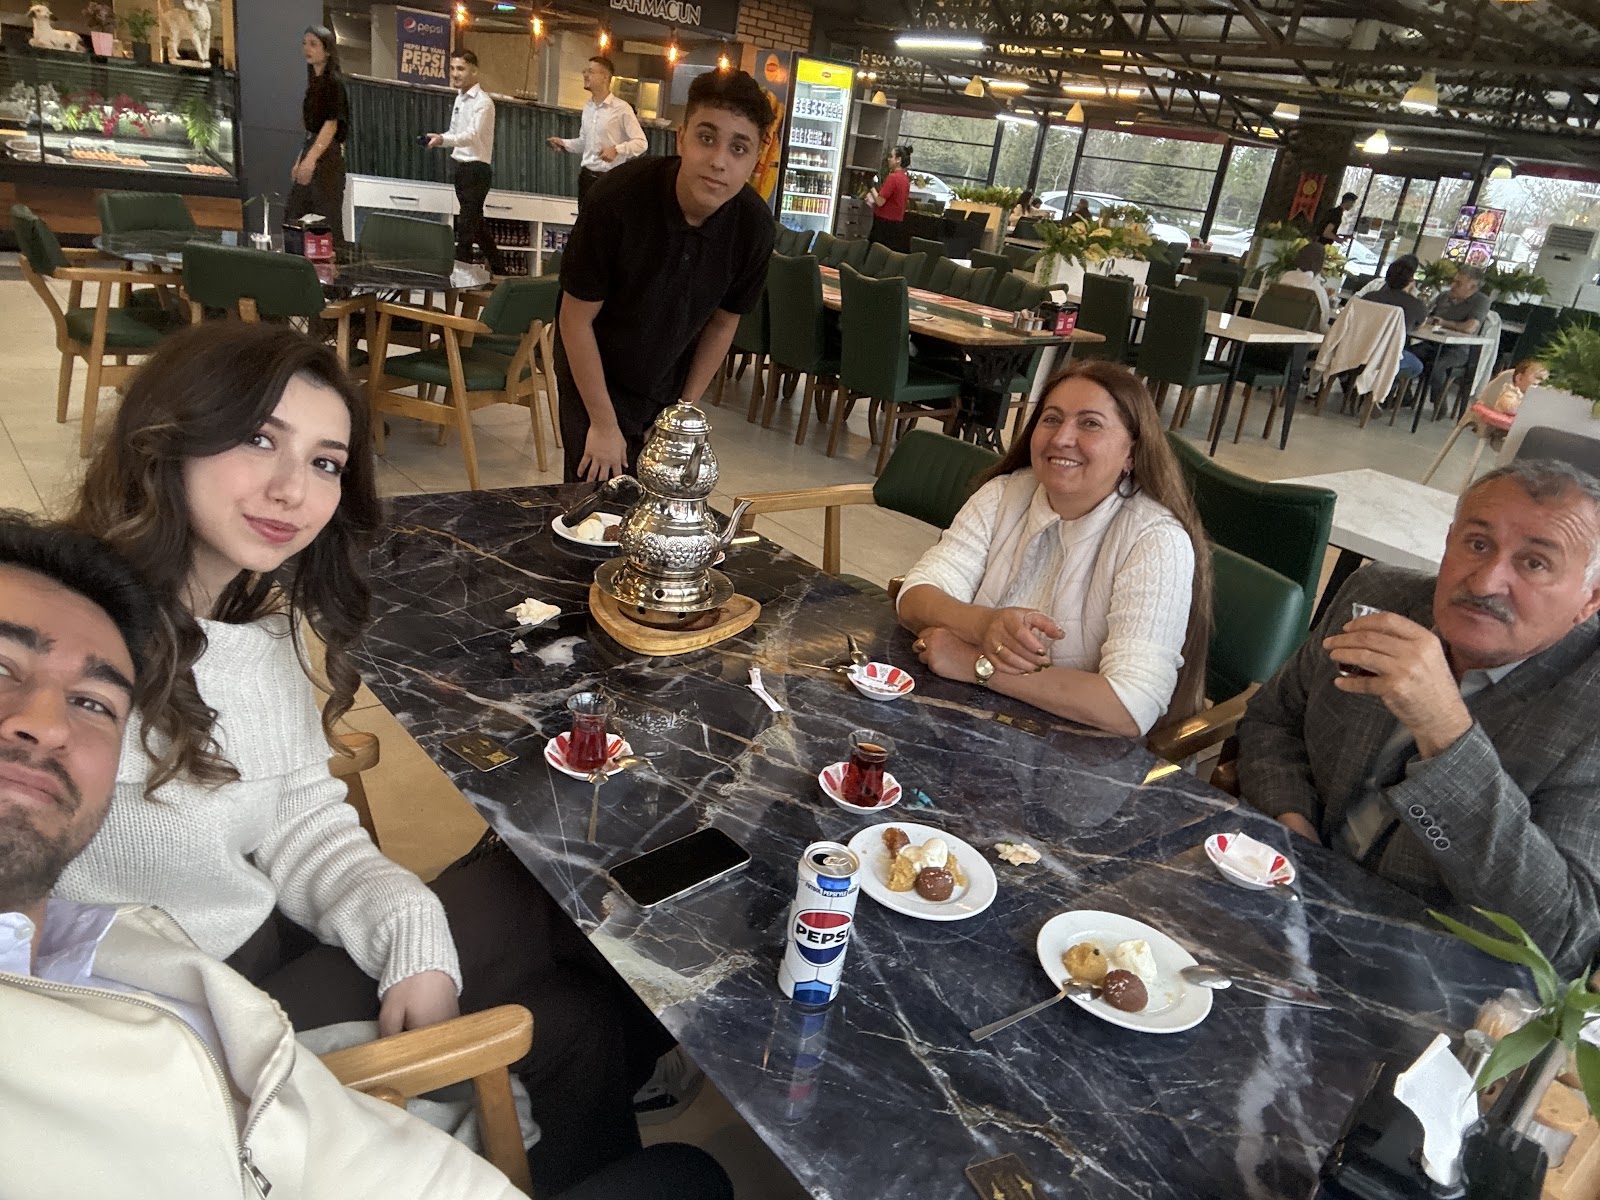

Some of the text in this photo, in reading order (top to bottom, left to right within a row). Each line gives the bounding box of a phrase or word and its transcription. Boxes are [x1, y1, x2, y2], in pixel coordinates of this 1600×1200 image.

[417, 23, 444, 34] pepsi
[402, 49, 446, 68] PEPSI
[418, 65, 446, 78] YANA
[796, 922, 849, 944] PEPSI
